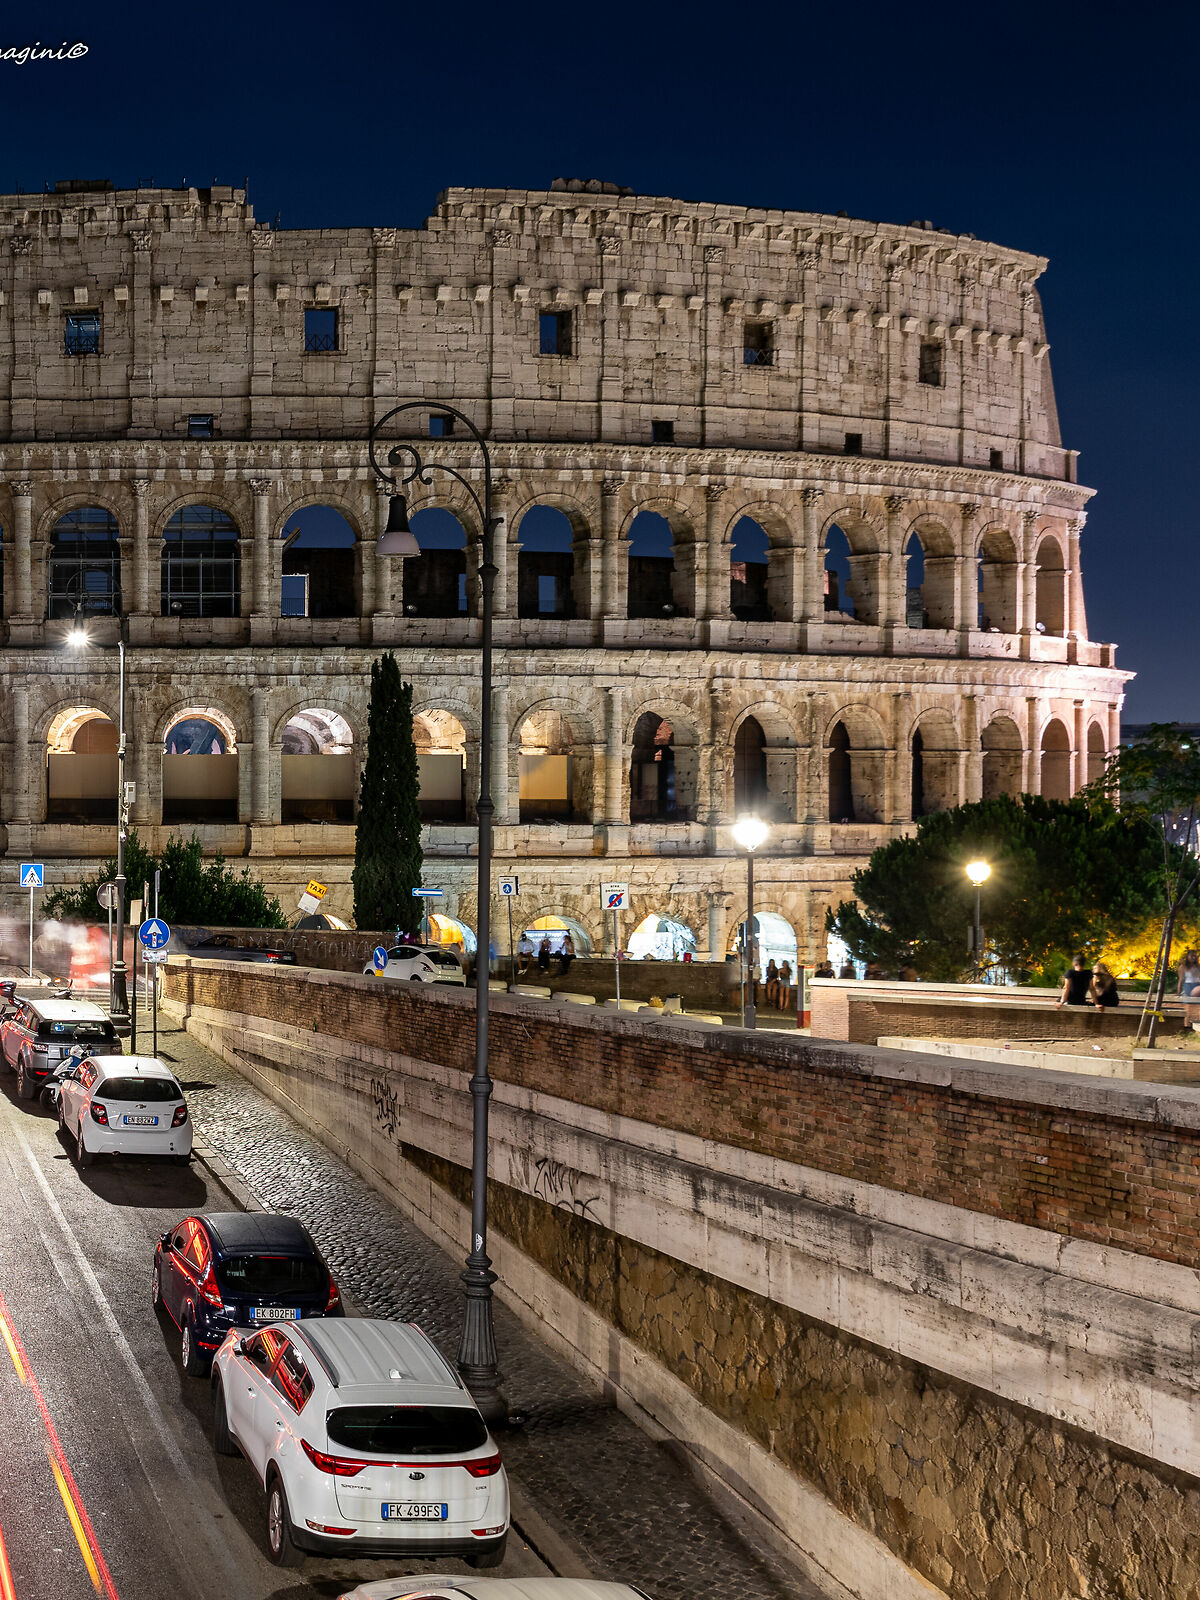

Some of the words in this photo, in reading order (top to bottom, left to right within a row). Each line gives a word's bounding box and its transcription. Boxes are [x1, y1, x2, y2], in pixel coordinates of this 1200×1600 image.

[310, 883, 325, 895] TAXI
[256, 1309, 266, 1318] EK
[270, 1309, 295, 1318] 802FH
[389, 1504, 403, 1517] FK
[407, 1504, 440, 1517] 499FS
